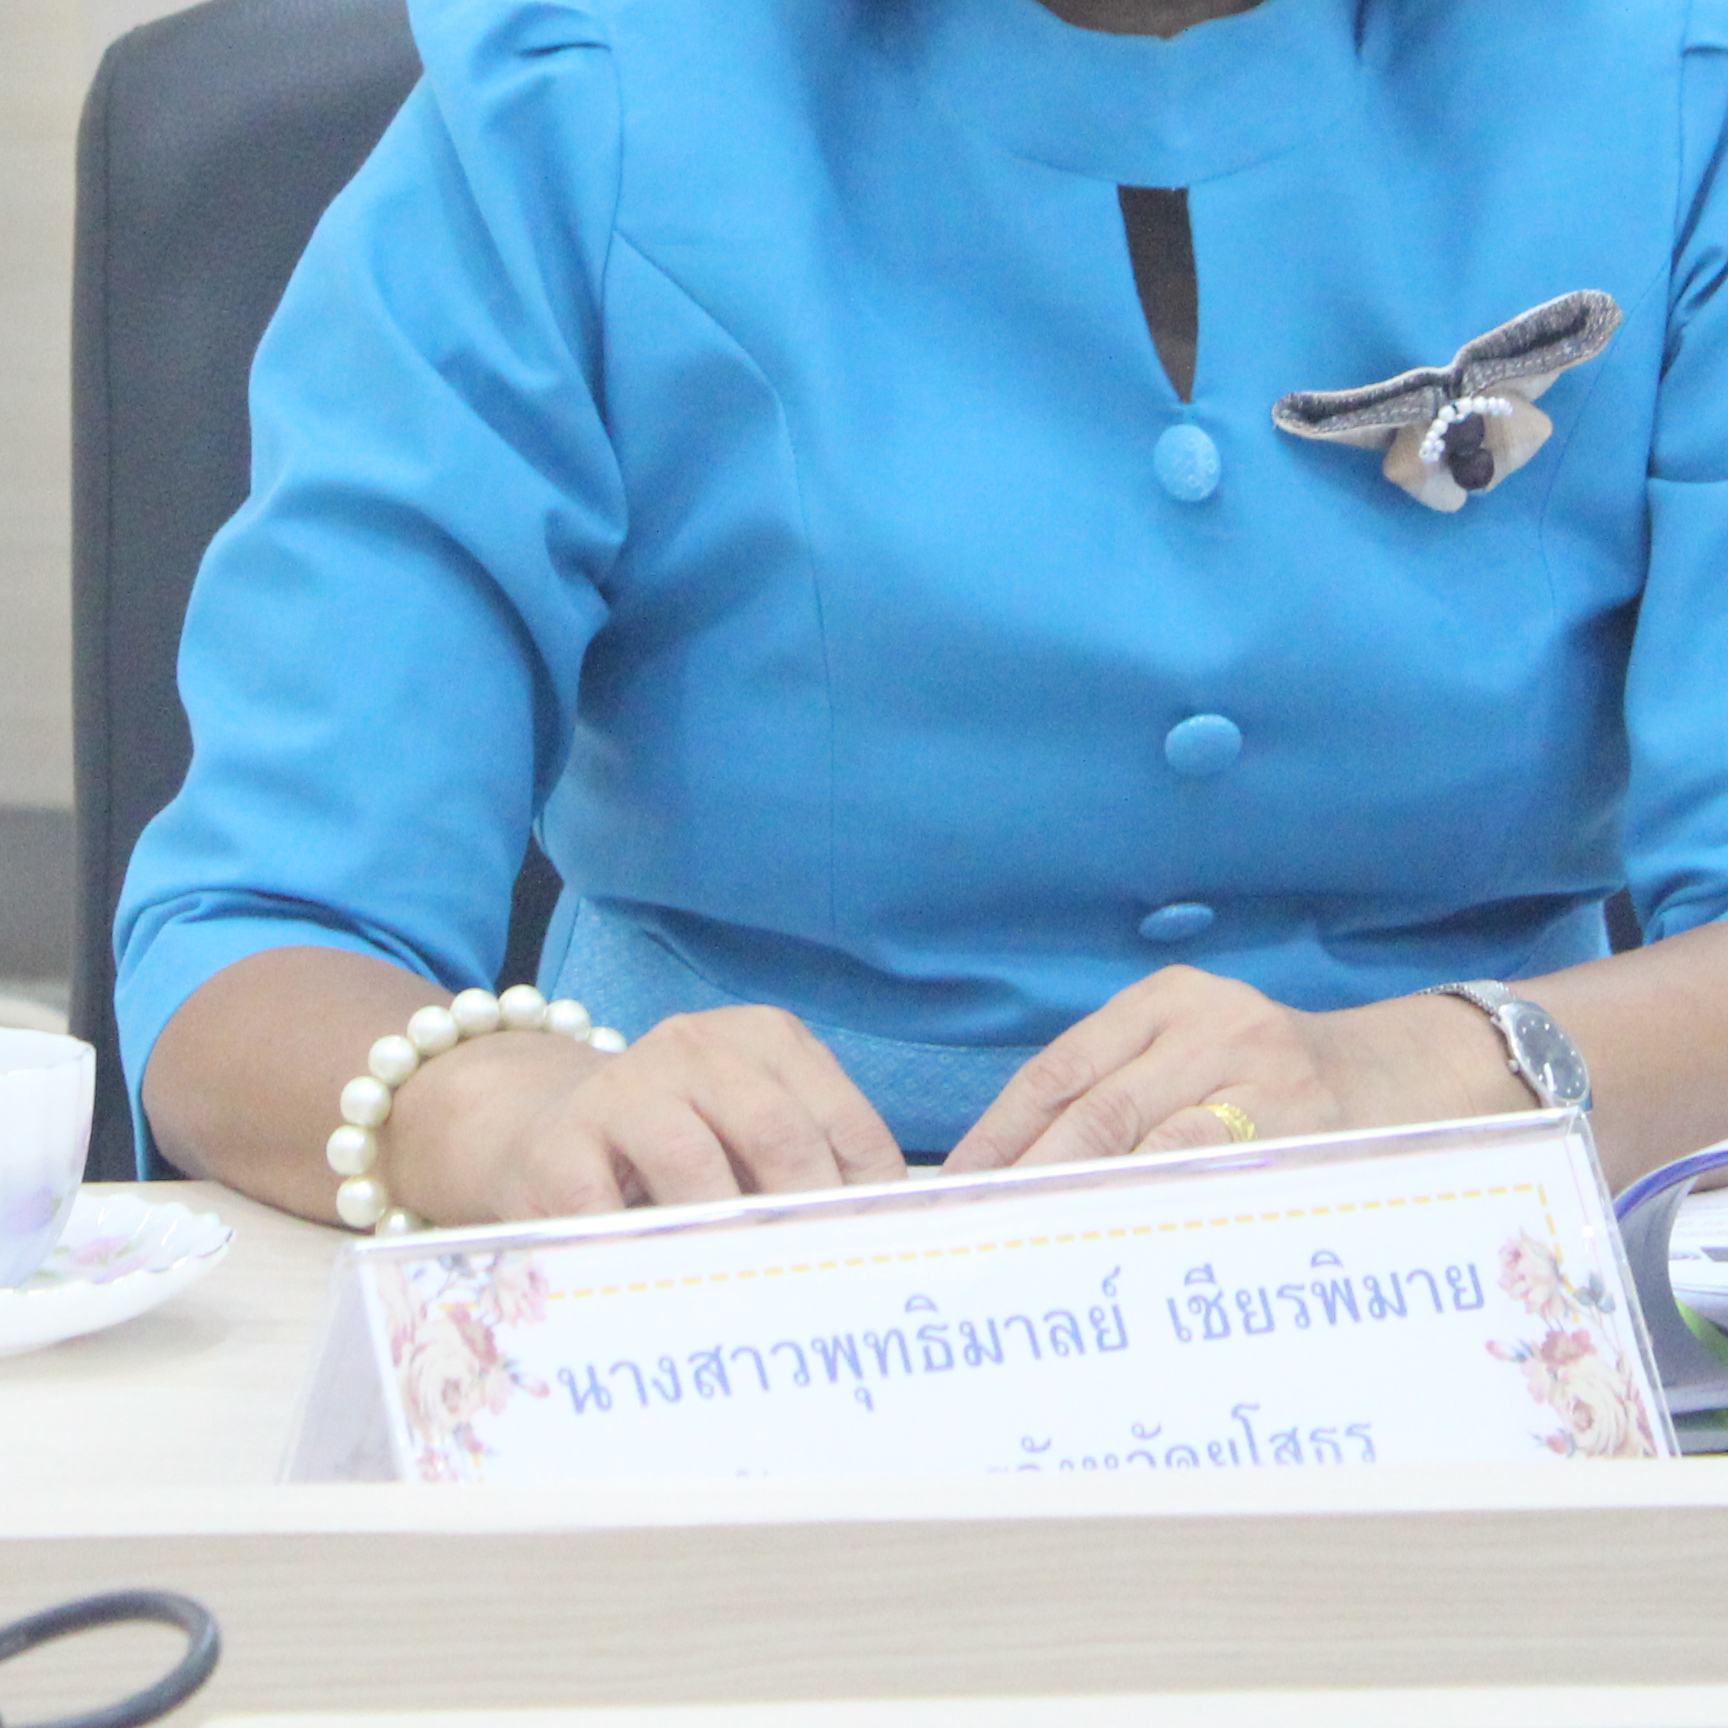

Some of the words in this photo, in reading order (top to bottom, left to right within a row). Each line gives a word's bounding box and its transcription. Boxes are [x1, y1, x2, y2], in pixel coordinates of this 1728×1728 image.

[557, 1264, 1130, 1414] นางสาวพุทธิมาลย์
[1165, 1248, 1486, 1345] เชียรพิมาย
